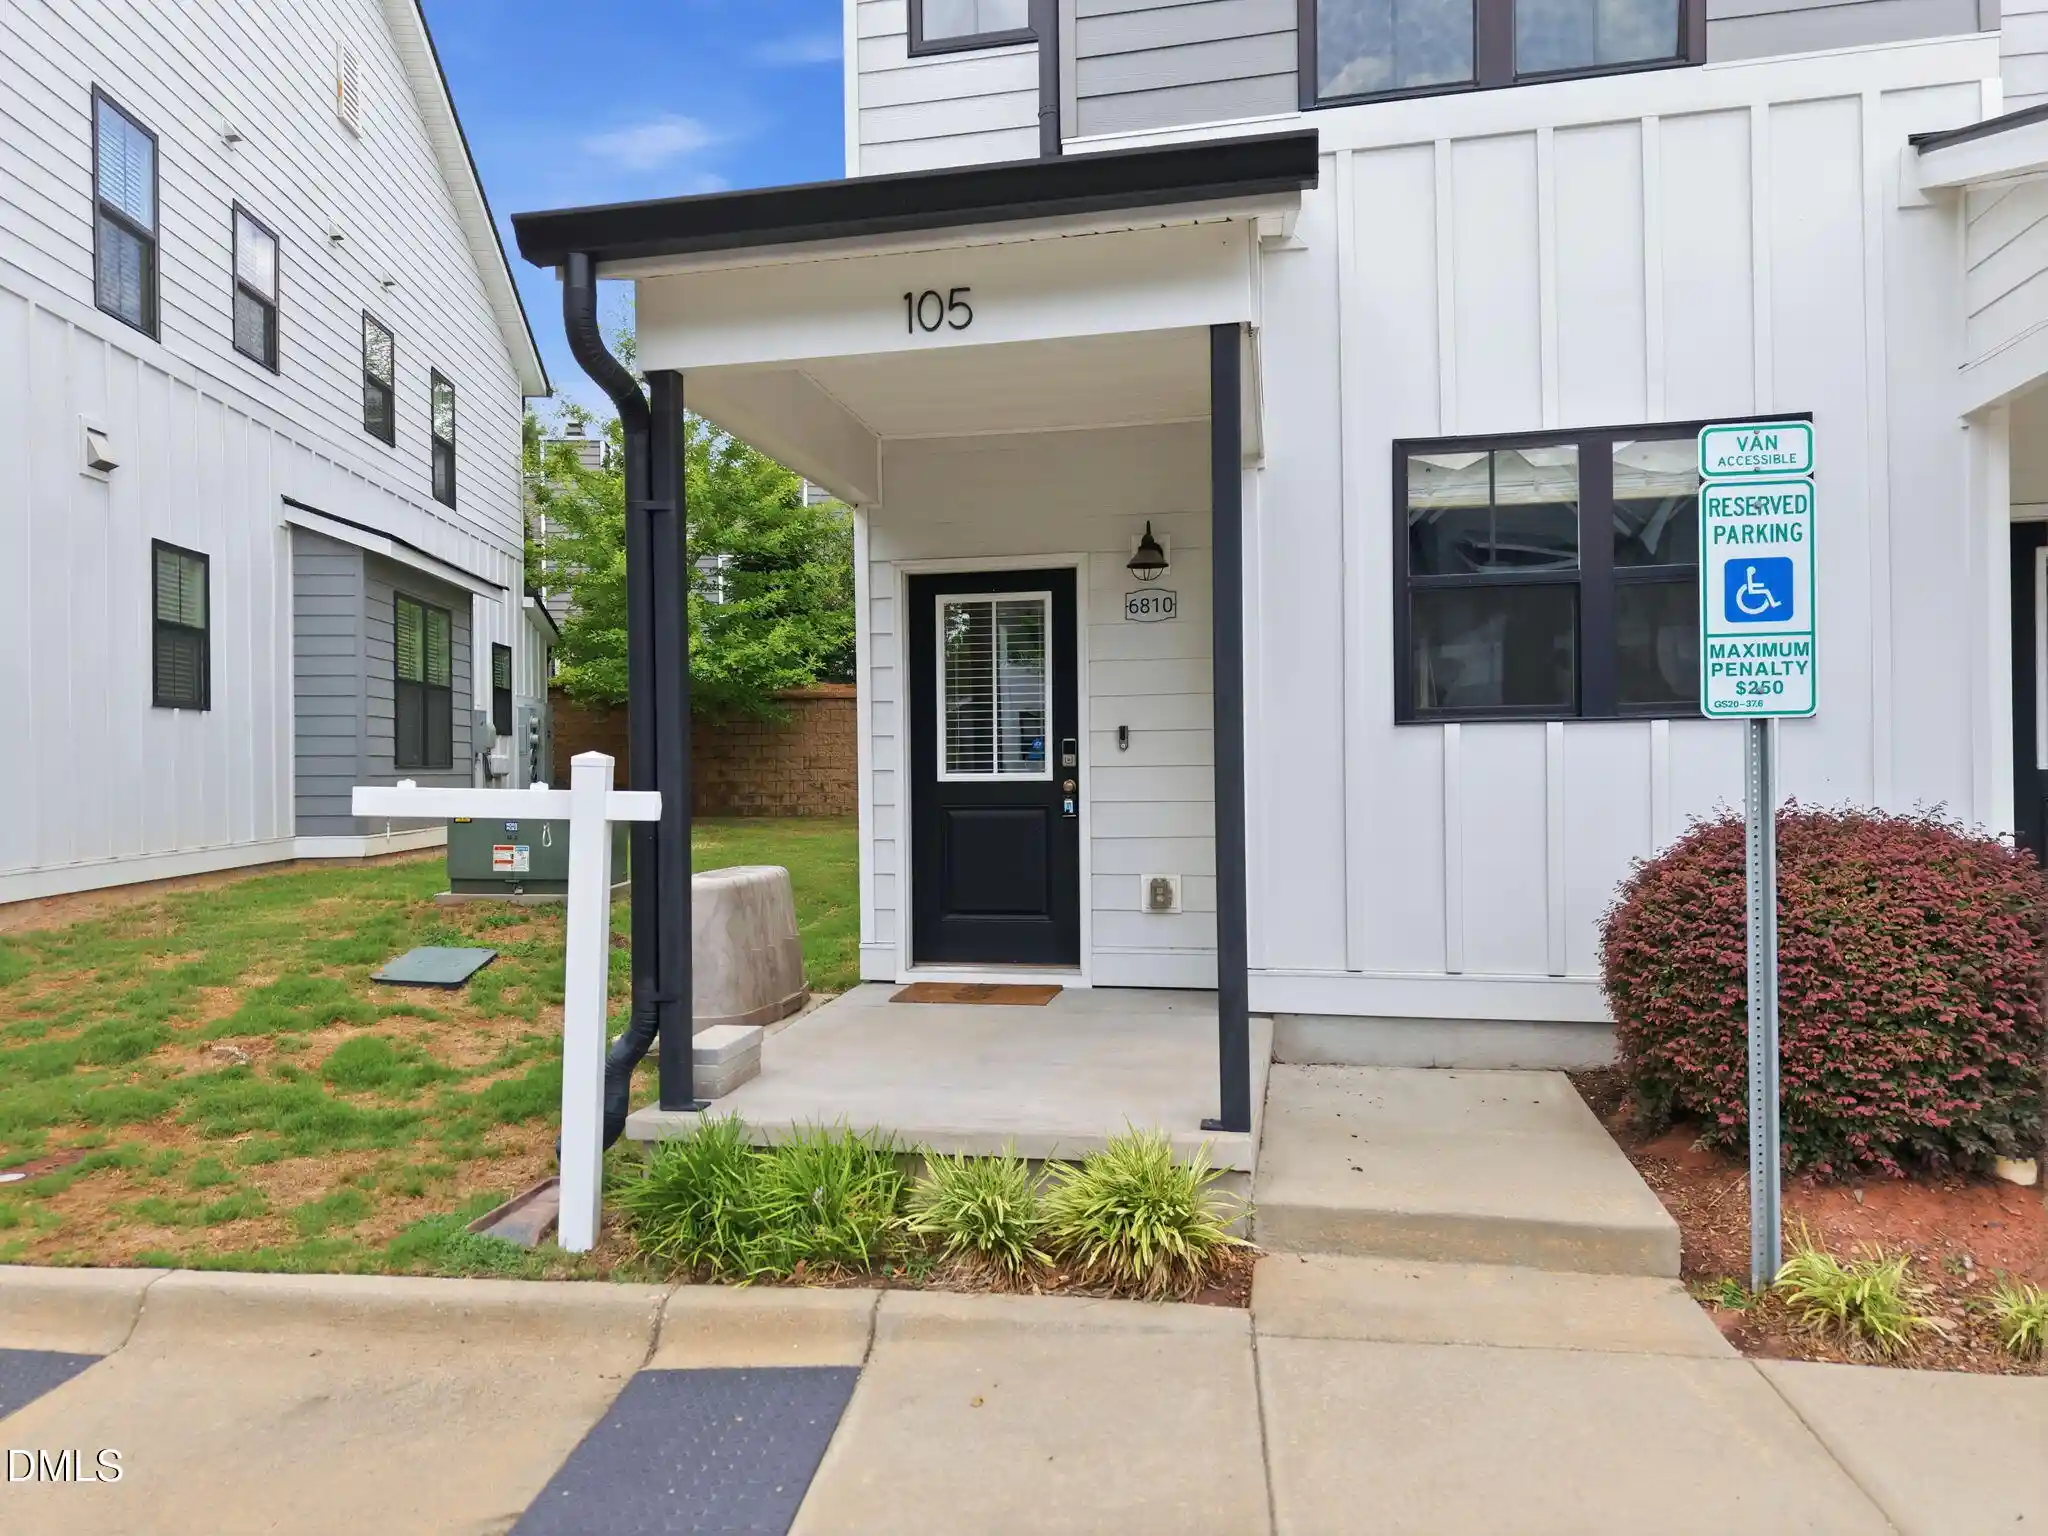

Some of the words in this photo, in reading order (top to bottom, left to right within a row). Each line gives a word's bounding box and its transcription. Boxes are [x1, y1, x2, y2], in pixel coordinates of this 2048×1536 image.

[903, 287, 973, 334] 105
[1736, 434, 1778, 452] VAN
[1718, 453, 1797, 467] ACCESSIBLE
[1708, 494, 1808, 518] RESERVED
[1713, 522, 1803, 545] PARKING
[1129, 597, 1173, 614] 6810
[1709, 642, 1810, 659] MAXIMUM
[1711, 660, 1808, 677] PENALTY
[1735, 680, 1784, 696] $250
